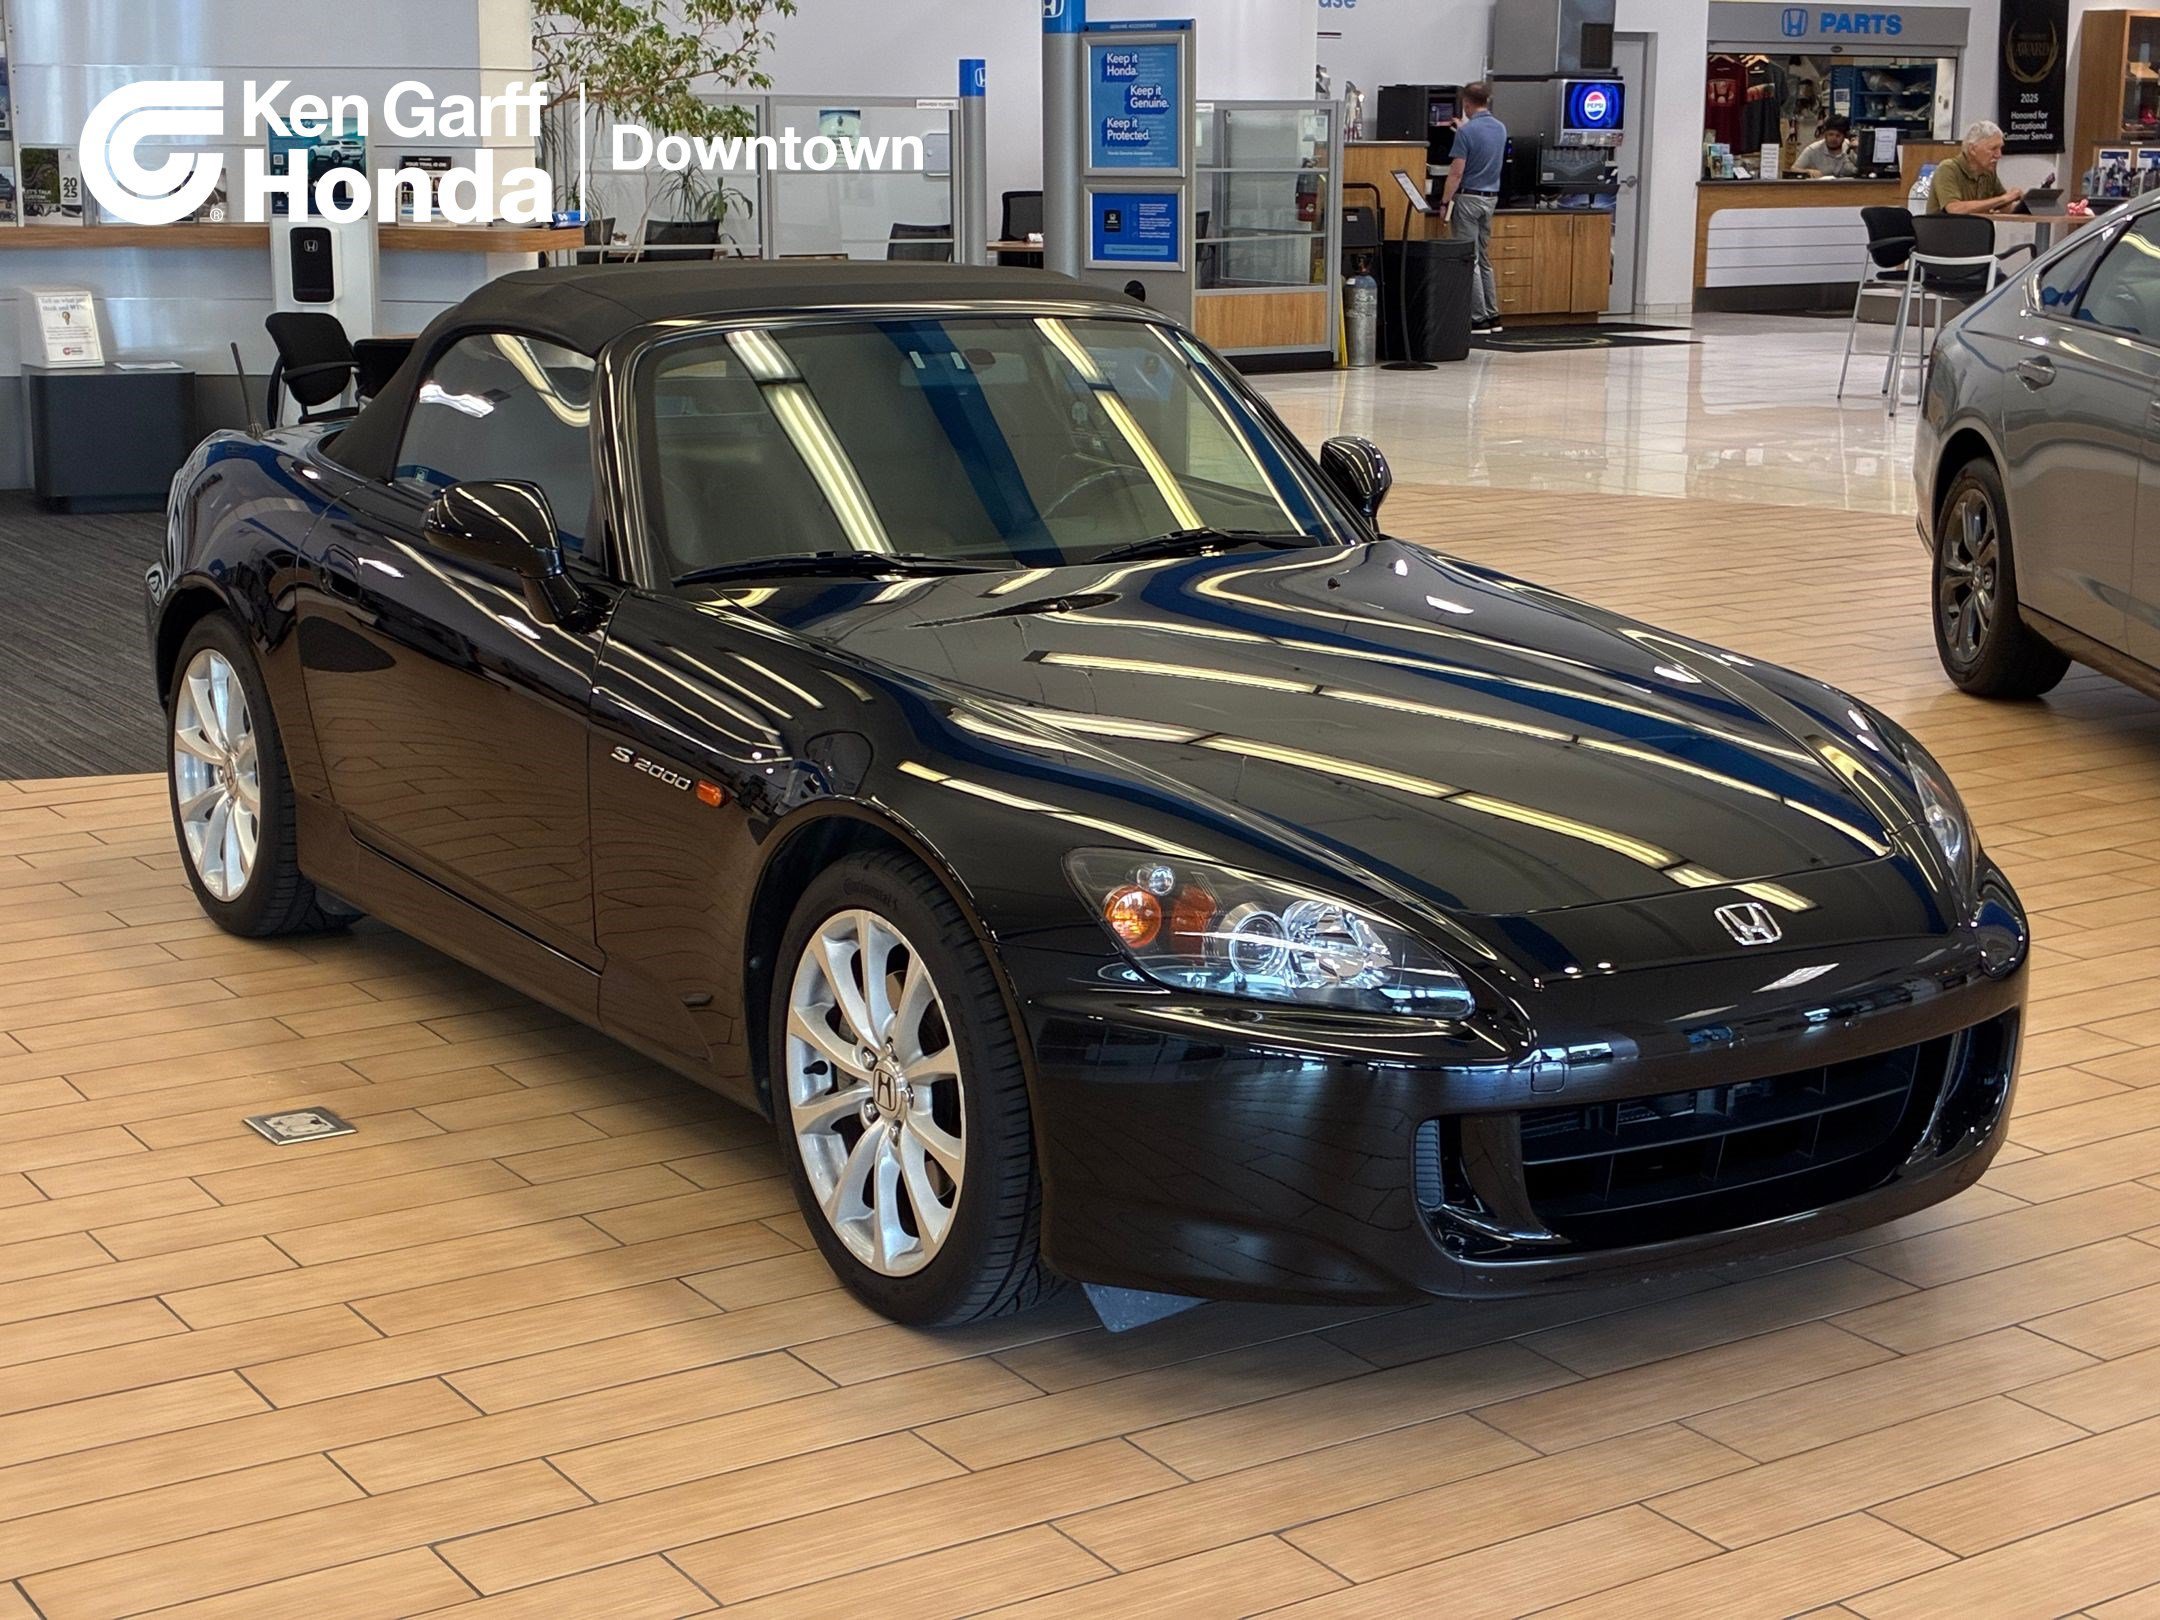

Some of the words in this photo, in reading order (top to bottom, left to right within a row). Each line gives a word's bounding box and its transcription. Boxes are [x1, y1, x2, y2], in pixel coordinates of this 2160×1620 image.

[1819, 12, 1903, 36] PARTS
[1106, 52, 1130, 66] Keep
[1131, 52, 1138, 65] it
[1106, 65, 1139, 77] Honda.
[1130, 85, 1154, 99] Keep
[1155, 85, 1162, 97] it
[1130, 96, 1170, 109] Genuine.
[2020, 93, 2039, 104] 2025
[2011, 111, 2037, 120] Honored
[2038, 111, 2048, 119] for
[1106, 117, 1130, 131] Keep
[1131, 117, 1138, 129] it
[2011, 121, 2047, 133] Exceptional
[1106, 129, 1150, 141] Protected.
[2031, 131, 2054, 141] Service
[62, 176, 78, 188] 20
[63, 188, 78, 199] 25
